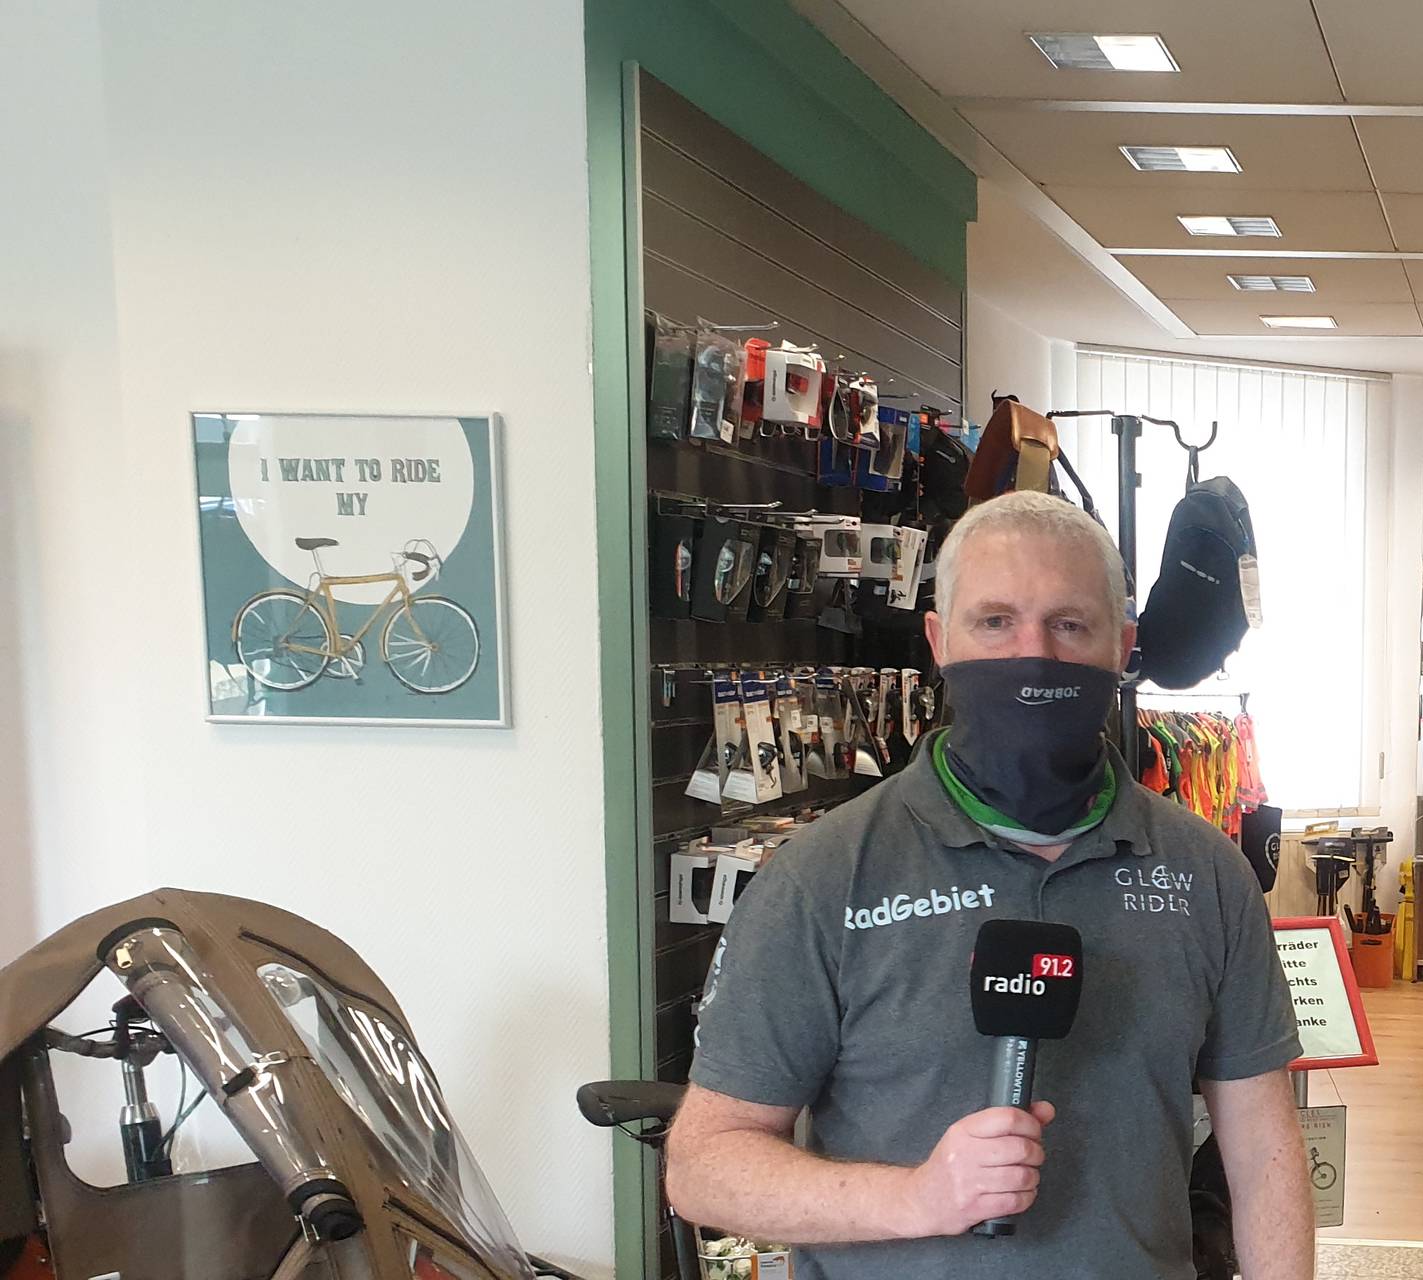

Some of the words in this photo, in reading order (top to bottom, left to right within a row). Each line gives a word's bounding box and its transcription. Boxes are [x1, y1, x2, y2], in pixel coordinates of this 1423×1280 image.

[260, 458, 270, 482] I
[278, 458, 345, 483] WANT
[354, 458, 382, 482] TO
[390, 457, 441, 483] RIDE
[336, 492, 368, 516] MY
[1020, 686, 1081, 699] JOBRAD
[1114, 865, 1193, 891] GLOW
[1277, 941, 1319, 951] rräder
[1041, 957, 1073, 977] 91.2
[1282, 960, 1307, 968] itte
[984, 973, 1046, 996] radio
[1288, 977, 1318, 987] chts
[1294, 996, 1324, 1005] rken
[1296, 1017, 1327, 1027] anke
